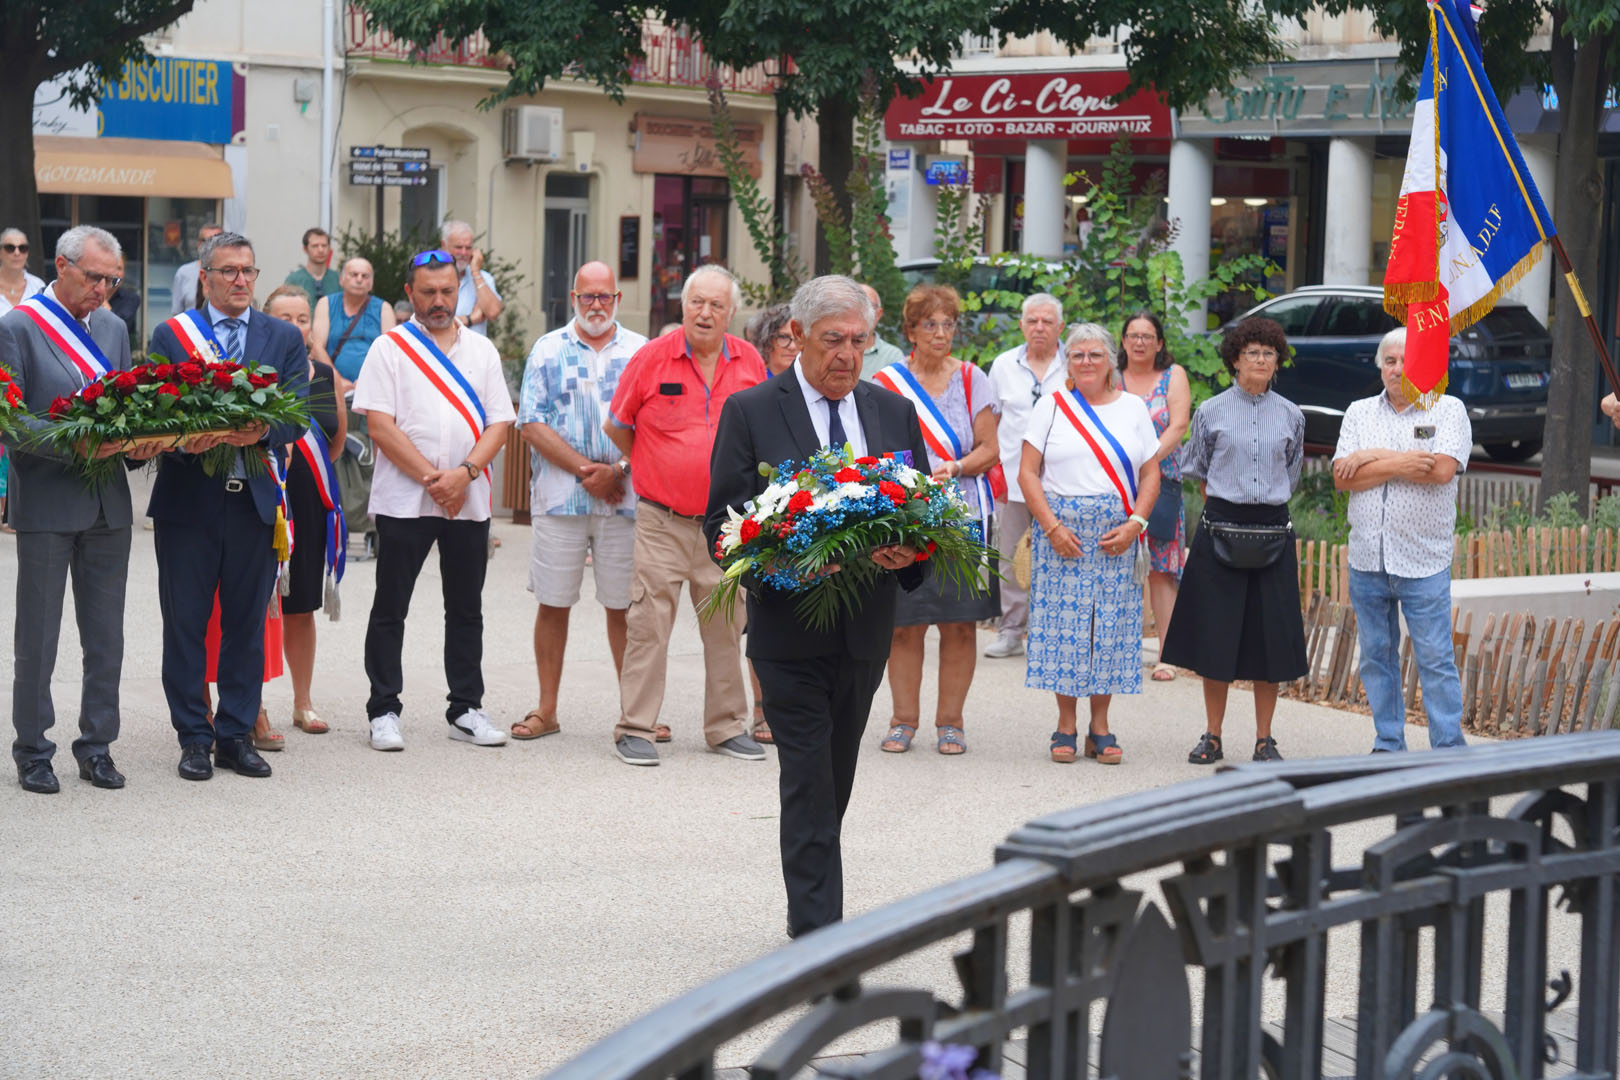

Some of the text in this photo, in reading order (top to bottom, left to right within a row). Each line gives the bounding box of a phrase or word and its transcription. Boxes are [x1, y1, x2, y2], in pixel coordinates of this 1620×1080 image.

[118, 57, 218, 105] BISCUITIER
[921, 77, 1119, 116] Le Ci-Clope
[899, 123, 945, 135] TABAC
[955, 122, 994, 135] LOTO
[1005, 121, 1055, 135] BAZAR
[1066, 120, 1152, 134] JOURNAUX
[38, 164, 156, 186] GOURMANDE
